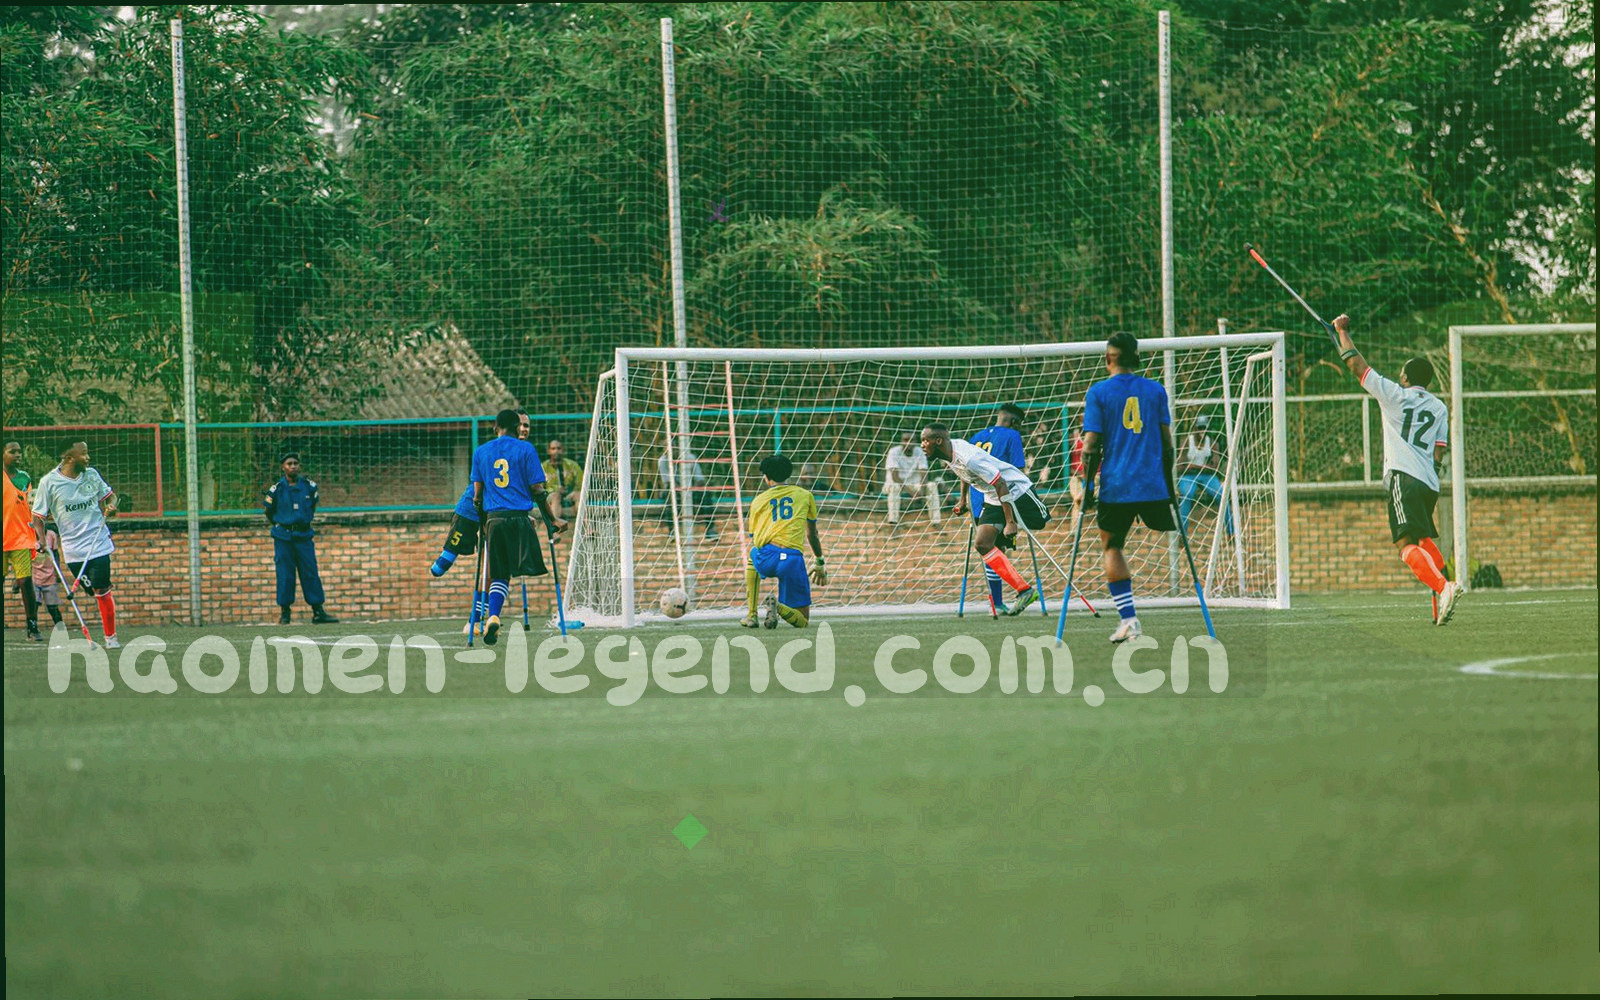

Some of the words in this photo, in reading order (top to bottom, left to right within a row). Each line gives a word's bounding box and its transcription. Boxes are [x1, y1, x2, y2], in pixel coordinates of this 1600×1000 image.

[1122, 396, 1143, 434] 4
[1400, 407, 1436, 451] 12
[493, 458, 510, 488] 3
[65, 499, 95, 513] Kenya
[769, 496, 794, 522] 16
[450, 531, 462, 546] 5
[80, 574, 92, 588] 8
